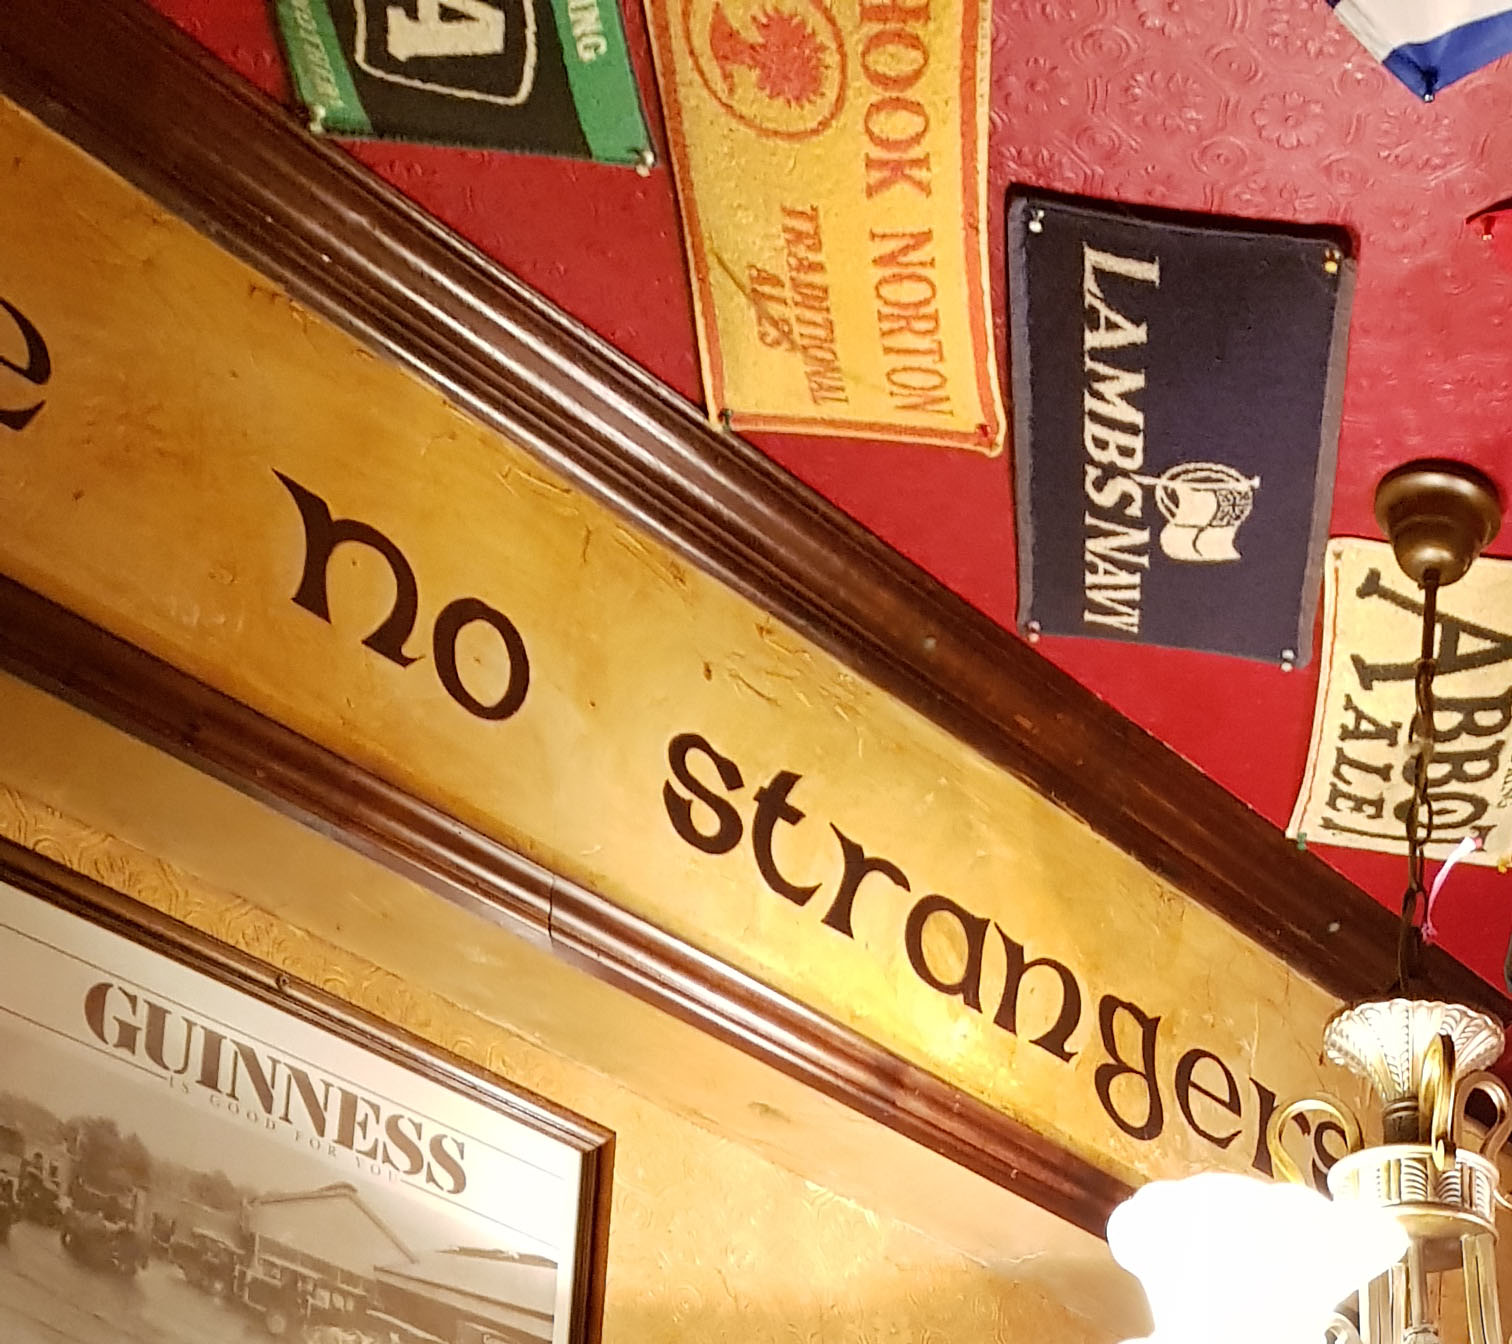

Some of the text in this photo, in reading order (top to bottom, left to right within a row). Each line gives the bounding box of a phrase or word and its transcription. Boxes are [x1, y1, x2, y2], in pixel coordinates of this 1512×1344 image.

[748, 264, 795, 352] ALES
[780, 203, 850, 406] TRADITIONAL
[869, 227, 954, 419] NORTON
[271, 467, 531, 721] no
[1083, 510, 1151, 634] NAVY
[1324, 693, 1402, 826] ALE
[83, 981, 468, 1195] GUINNESS
[167, 1075, 192, 1095] IS
[209, 1093, 278, 1131] GOOD
[294, 1129, 338, 1158] FOR
